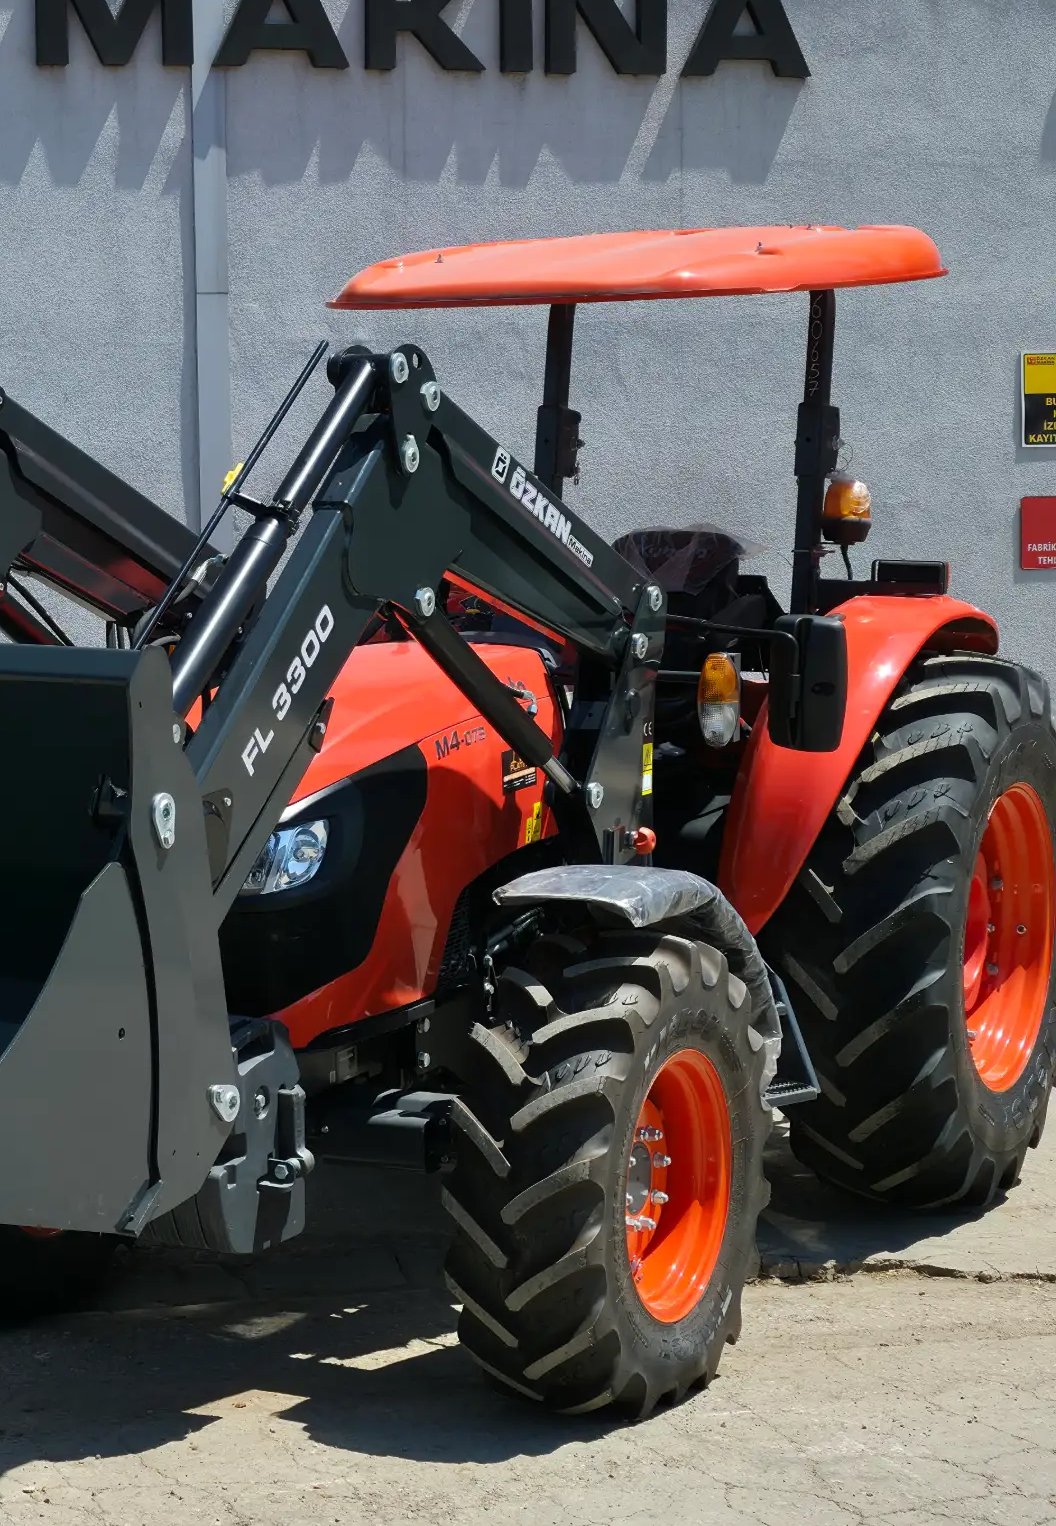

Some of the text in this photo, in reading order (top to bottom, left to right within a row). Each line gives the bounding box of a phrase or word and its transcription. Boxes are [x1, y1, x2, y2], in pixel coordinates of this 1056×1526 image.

[509, 465, 593, 566] ÖZKAN Makina
[241, 604, 334, 777] FL 3300
